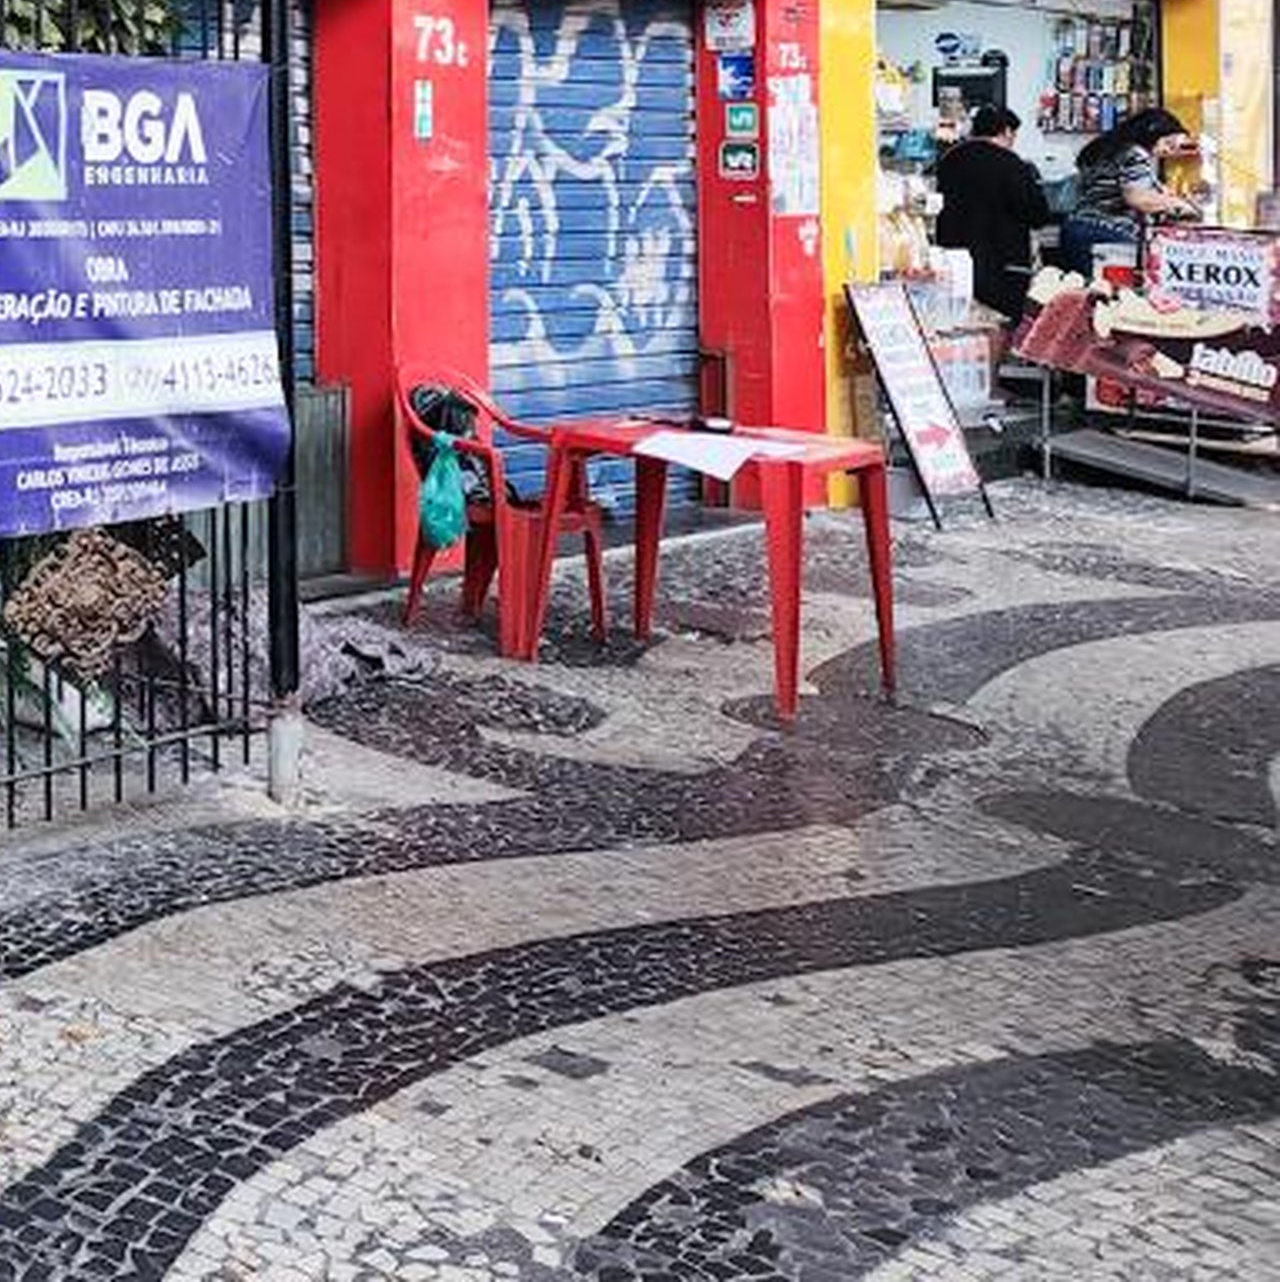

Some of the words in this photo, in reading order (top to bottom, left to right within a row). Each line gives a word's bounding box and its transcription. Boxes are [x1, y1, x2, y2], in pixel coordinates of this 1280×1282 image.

[81, 89, 207, 164] BGA
[1165, 260, 1262, 288] XEROX
[74, 292, 89, 318] E
